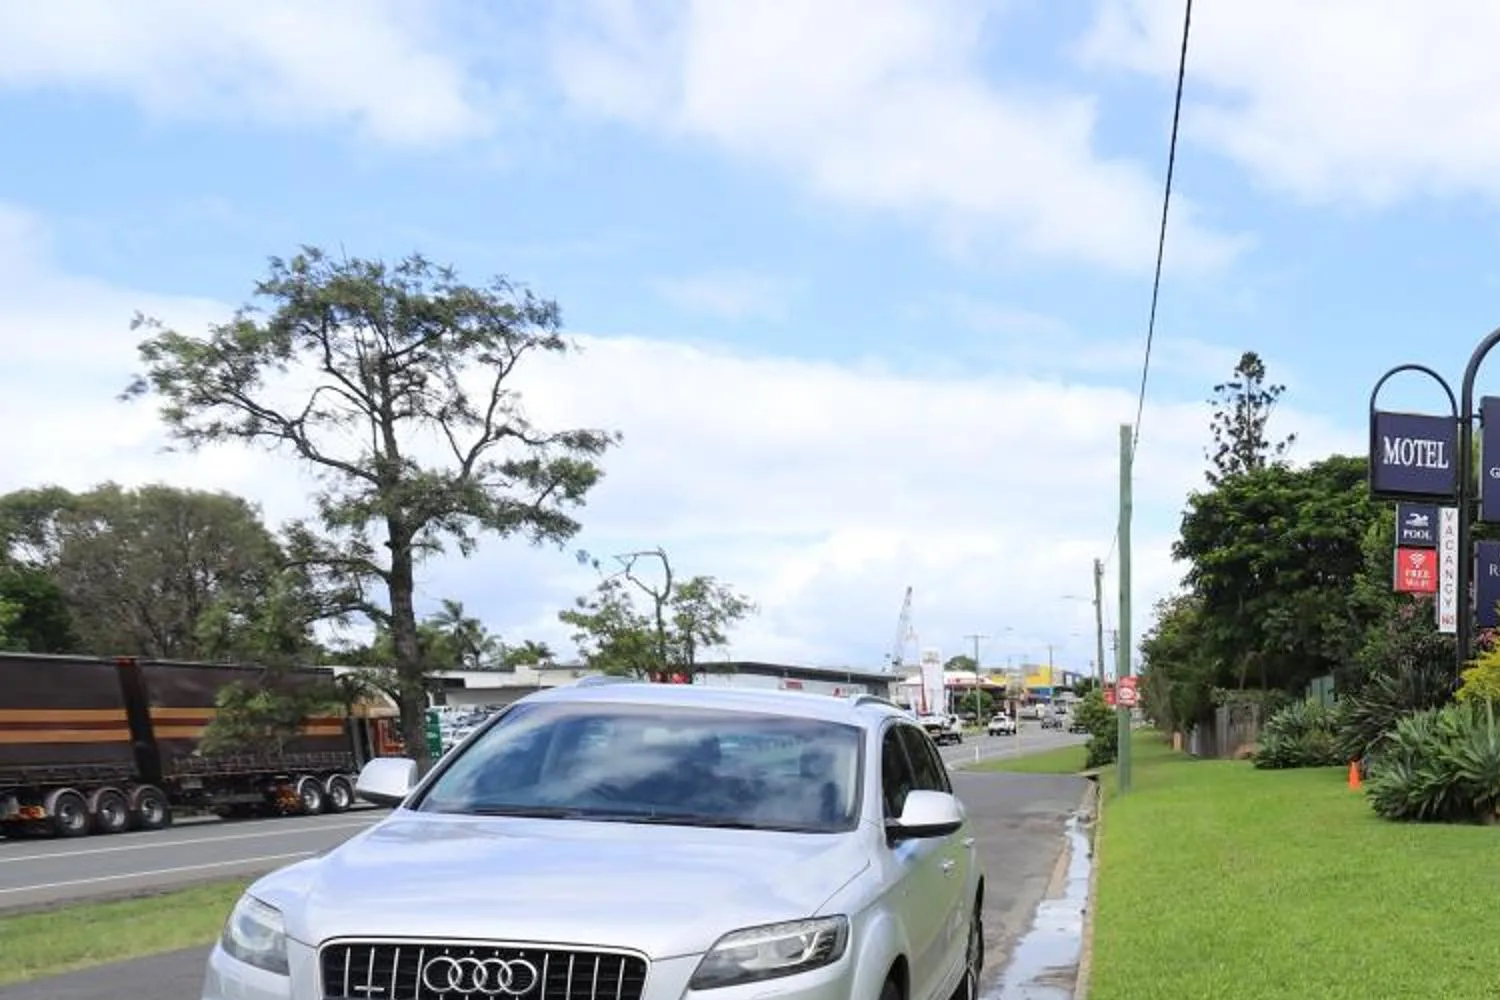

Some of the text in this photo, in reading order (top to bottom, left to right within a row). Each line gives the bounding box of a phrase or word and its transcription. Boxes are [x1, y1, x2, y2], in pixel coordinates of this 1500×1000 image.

[1383, 435, 1449, 469] MOTEL
[1403, 529, 1432, 542] POOL
[1444, 511, 1454, 607] VACANCY
